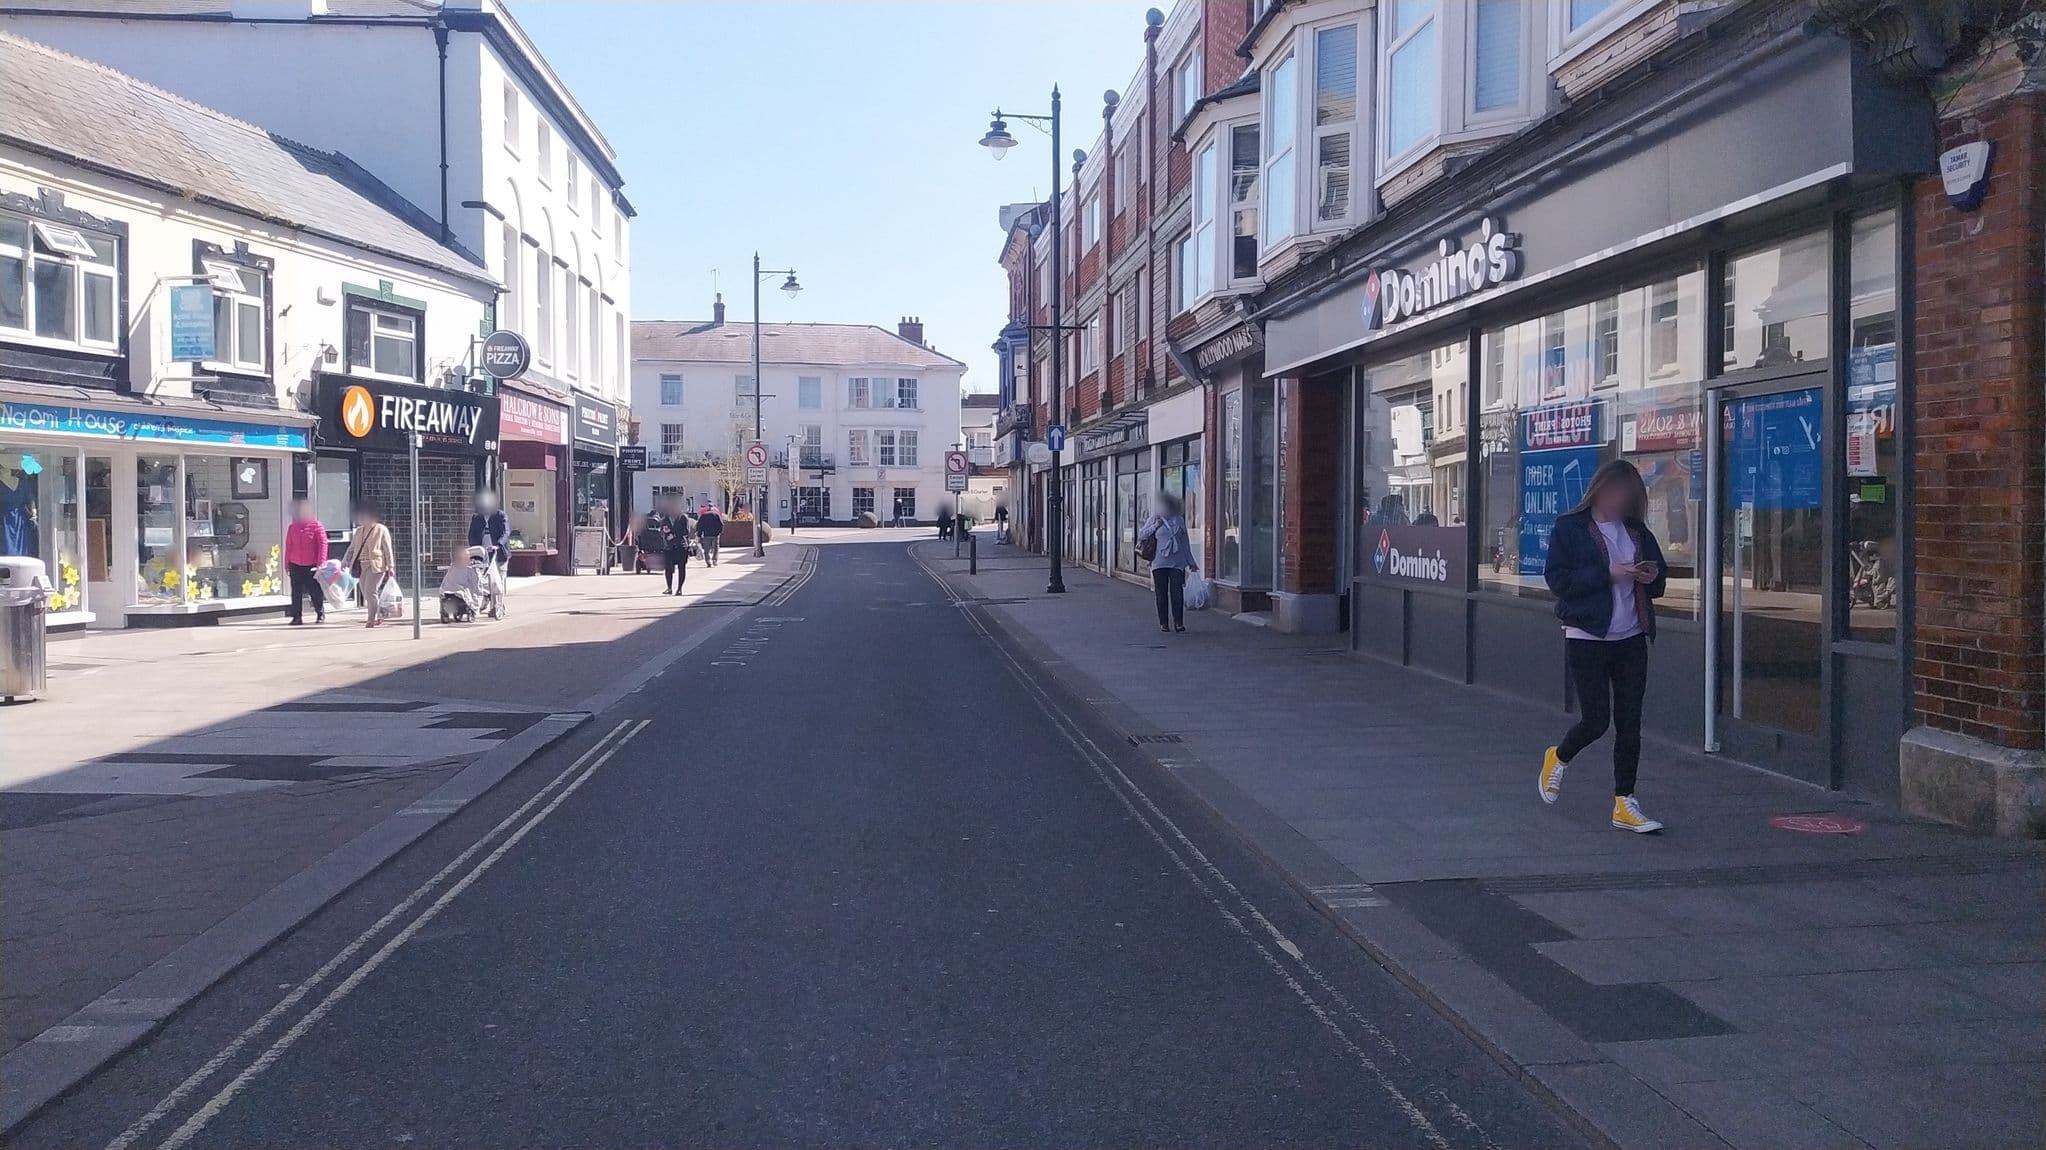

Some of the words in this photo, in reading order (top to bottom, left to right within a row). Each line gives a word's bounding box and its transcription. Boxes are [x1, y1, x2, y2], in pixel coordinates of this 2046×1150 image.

[1946, 160, 1970, 173] SECURITY
[1950, 152, 1968, 163] TAMAR
[1380, 217, 1507, 324] Domino's
[486, 352, 520, 365] PIZZA
[1197, 335, 1234, 369] HOLLYWOOD
[1232, 326, 1253, 352] NAILS
[68, 408, 127, 434] House
[381, 395, 482, 444] FIREAWAY
[503, 394, 538, 420] HALCROW
[543, 406, 560, 426] SONS
[1525, 464, 1554, 487] ORDER
[1525, 491, 1558, 514] ONLINE
[1390, 548, 1447, 581] Domino's
